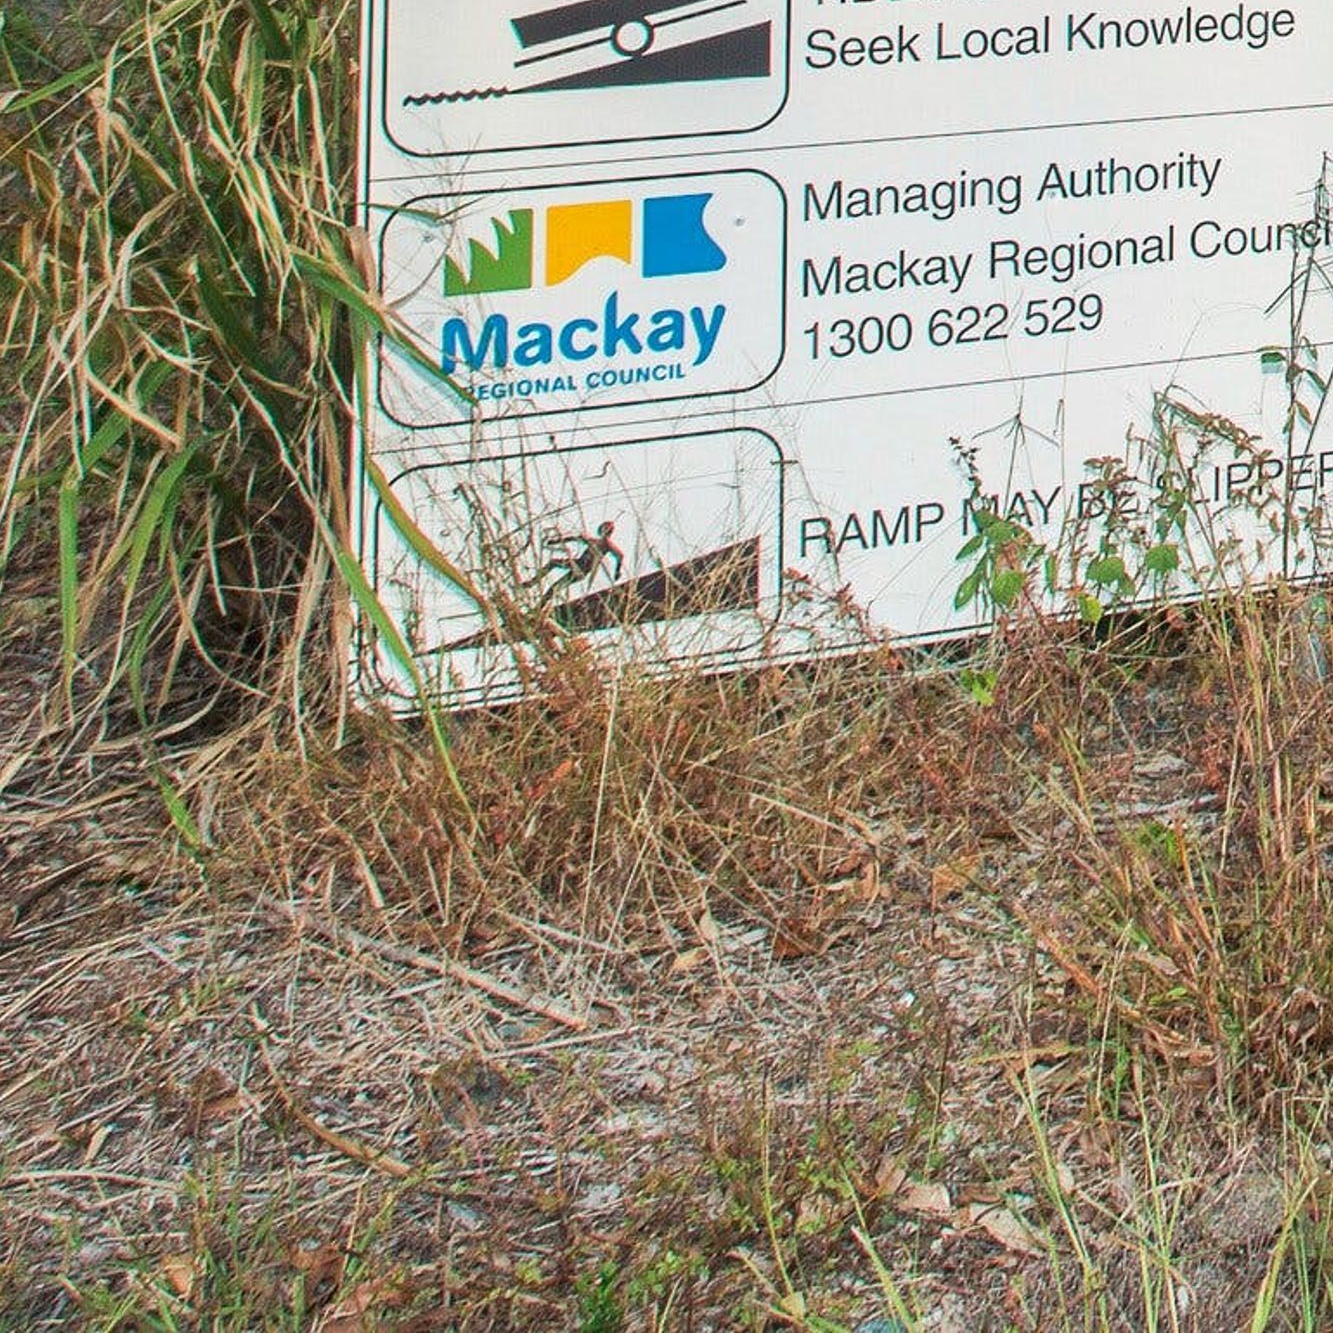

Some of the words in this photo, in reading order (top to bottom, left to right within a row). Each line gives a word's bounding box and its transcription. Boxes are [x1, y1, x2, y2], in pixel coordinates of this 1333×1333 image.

[806, 25, 920, 69] Seek
[937, 16, 1049, 60] Local
[1068, 4, 1294, 51] Knowledge
[803, 170, 1022, 223] Managing
[1037, 154, 1221, 200] Authority
[802, 250, 970, 301] Mackay
[989, 227, 1174, 283] Regional
[441, 290, 726, 375] Mackay
[803, 319, 912, 360] 1300
[929, 304, 1008, 346] 622
[1025, 294, 1102, 336] 529
[586, 364, 685, 389] COUNCIL
[800, 502, 944, 557] RAMP
[962, 485, 1062, 537] MAY
